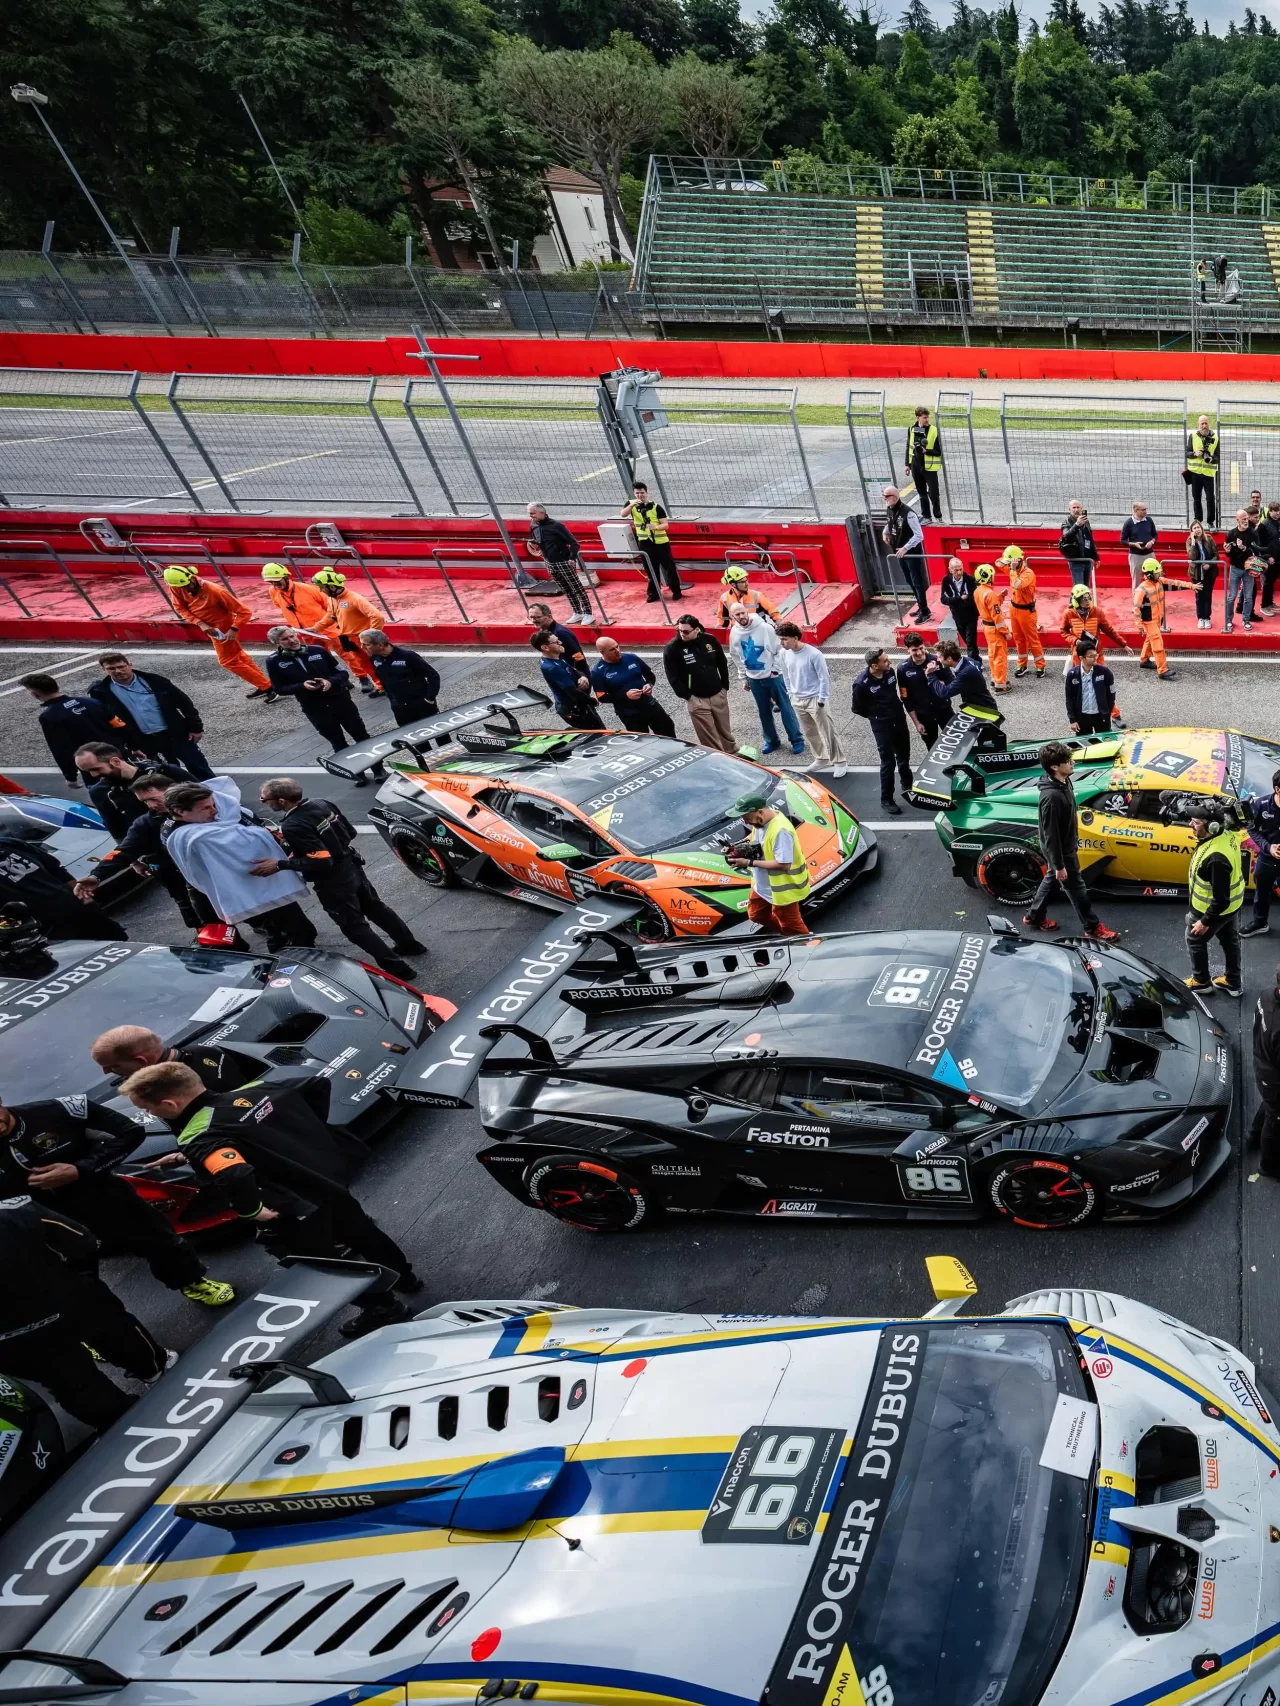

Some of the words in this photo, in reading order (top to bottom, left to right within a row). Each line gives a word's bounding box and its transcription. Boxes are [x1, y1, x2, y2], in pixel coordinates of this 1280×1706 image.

[457, 733, 482, 744] ROGER
[482, 736, 506, 748] DUBUIS
[929, 711, 976, 765] randstad
[1228, 733, 1242, 759] DUBUIS
[600, 753, 645, 774] 33
[977, 754, 1011, 763] ROGER
[1012, 752, 1039, 761] DUBU
[1155, 755, 1185, 770] 14
[587, 777, 652, 810] ROGER
[650, 747, 708, 779] DUBUIS
[611, 812, 624, 825] 33
[484, 827, 525, 850] Fastron
[1101, 825, 1154, 840] Fastron
[527, 869, 568, 893] ACTIVE
[685, 868, 717, 883] ACTIVE
[809, 861, 838, 883] Fastron
[1153, 887, 1178, 895] AGRATI
[671, 916, 712, 926] Fastron
[476, 906, 613, 1023] randstad
[14, 946, 133, 1009] DUBUIS
[884, 966, 930, 1005] 86
[568, 987, 620, 1000] ROGER
[622, 985, 674, 998] DUBUIS
[915, 997, 963, 1065] ROGER
[950, 936, 985, 993] DUBUIS
[204, 1023, 240, 1048] amica
[960, 1057, 978, 1080] 86
[1218, 1048, 1228, 1084] Fastron
[350, 1063, 397, 1102] Fastron
[979, 1099, 998, 1114] UMAR
[747, 1127, 830, 1148] Fastron
[790, 1122, 831, 1134] PERTAMINA
[924, 1135, 947, 1153] AGRATI
[651, 1164, 702, 1172] CRITELLI
[905, 1167, 963, 1191] 86
[1110, 1173, 1160, 1193] Fastron
[778, 1201, 818, 1212] AGRATI
[1065, 1415, 1079, 1449] TECHNICAL
[1069, 1410, 1087, 1459] SCRUTINEERING
[1, 1293, 320, 1607] randstad
[723, 1446, 751, 1498] macron
[729, 1433, 816, 1530] 66
[803, 1465, 825, 1513] SQUADRA
[820, 1431, 836, 1464] CORSE
[189, 1501, 278, 1518] ROGER
[285, 1493, 376, 1512] DUBUIS
[787, 1498, 881, 1685] ROGER
[858, 1333, 921, 1480] DUBUIS
[1092, 1475, 1115, 1556] Dinamica
[831, 1672, 851, 1706] O-AM
